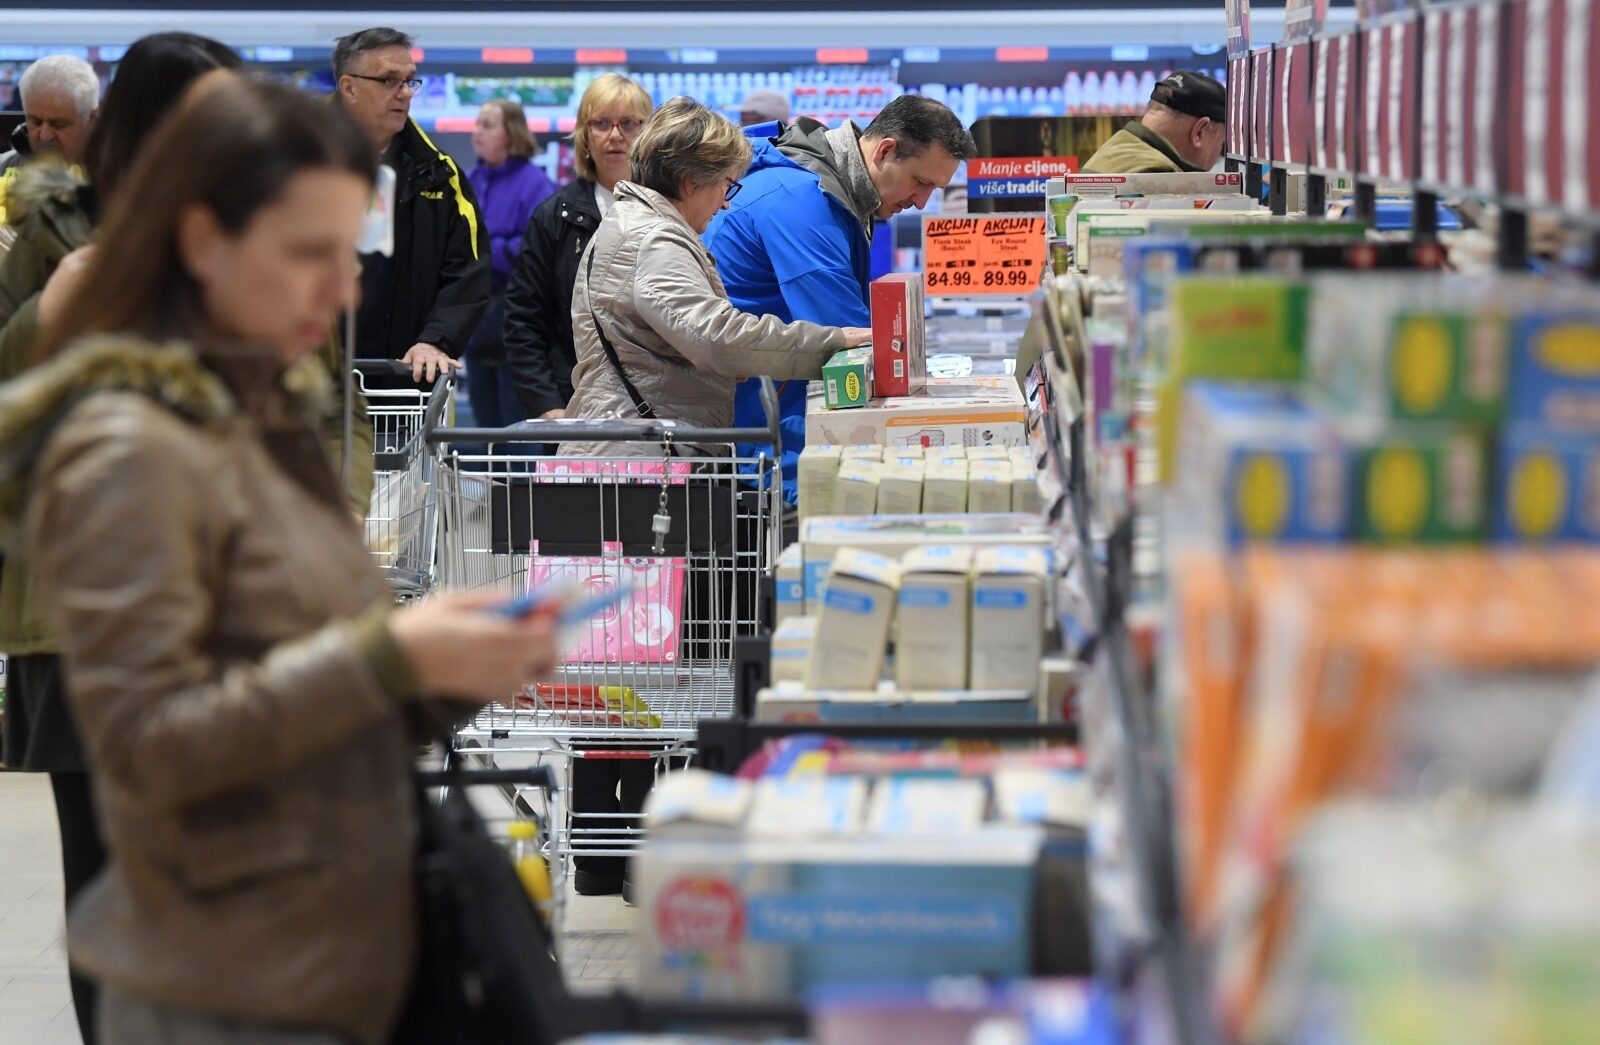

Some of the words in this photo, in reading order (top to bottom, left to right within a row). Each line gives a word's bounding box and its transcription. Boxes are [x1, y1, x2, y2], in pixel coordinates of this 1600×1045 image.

[979, 161, 1021, 177] Manje
[1023, 160, 1071, 176] cijene,
[979, 180, 1006, 194] više
[926, 218, 979, 234] AKCIJA!
[983, 217, 1035, 233] AKCIJA!
[927, 271, 971, 286] 84.99
[983, 270, 1027, 286] 89.99
